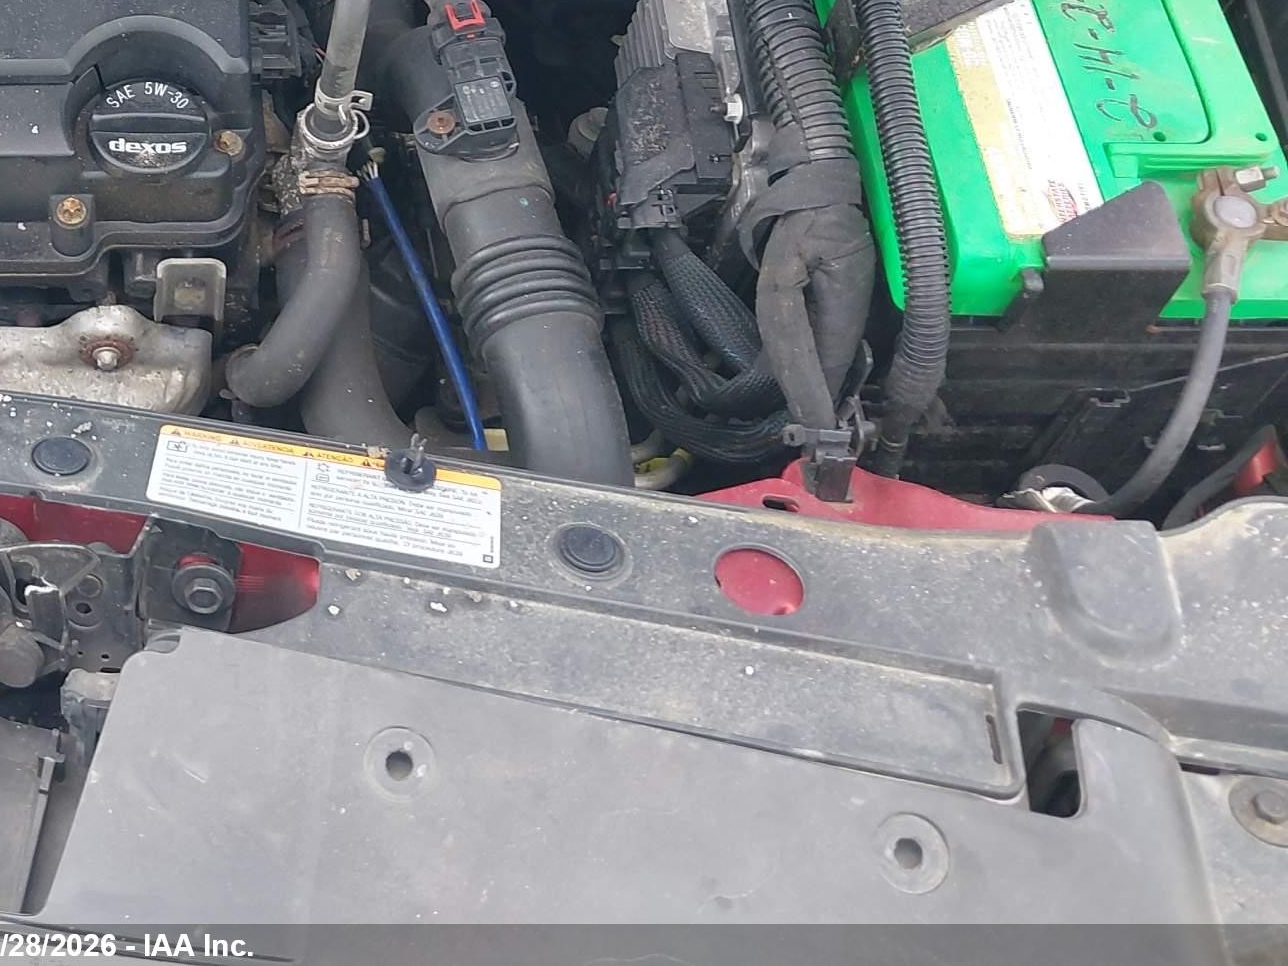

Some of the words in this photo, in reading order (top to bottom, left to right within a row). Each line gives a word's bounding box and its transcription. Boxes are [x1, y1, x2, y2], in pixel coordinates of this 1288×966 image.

[106, 84, 137, 108] SAE
[144, 81, 189, 109] 5W-30
[108, 137, 188, 154] dexos
